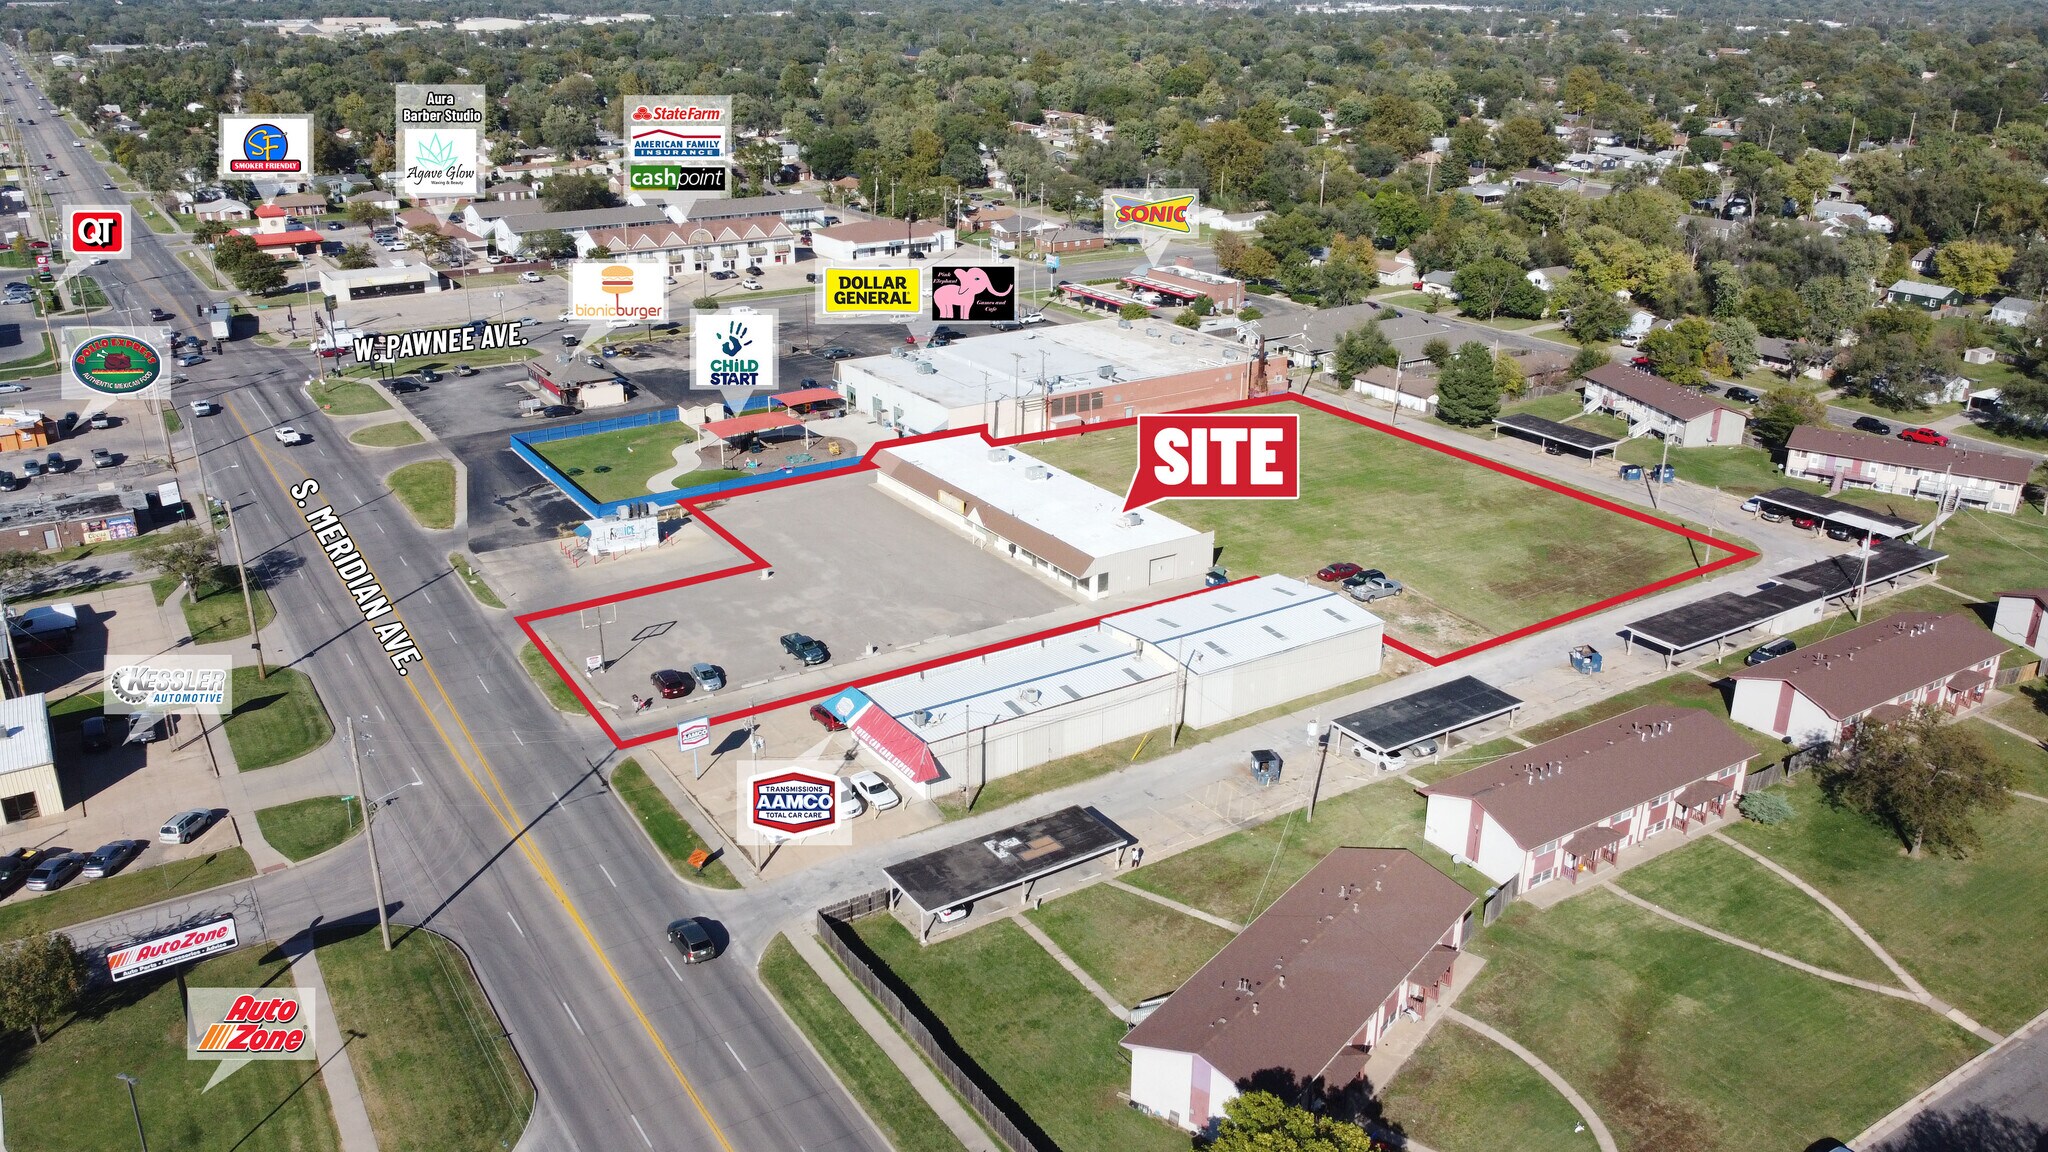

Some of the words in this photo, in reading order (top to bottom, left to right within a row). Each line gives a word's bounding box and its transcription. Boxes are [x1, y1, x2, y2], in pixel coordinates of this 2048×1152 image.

[854, 725, 871, 741] TOTAL
[869, 738, 881, 750] CAR
[879, 746, 895, 761] CARE
[122, 968, 139, 977] Auto
[139, 962, 157, 972] Parts
[162, 949, 201, 965] Accessories
[206, 941, 228, 952] Advice
[136, 926, 228, 963] AutoZone
